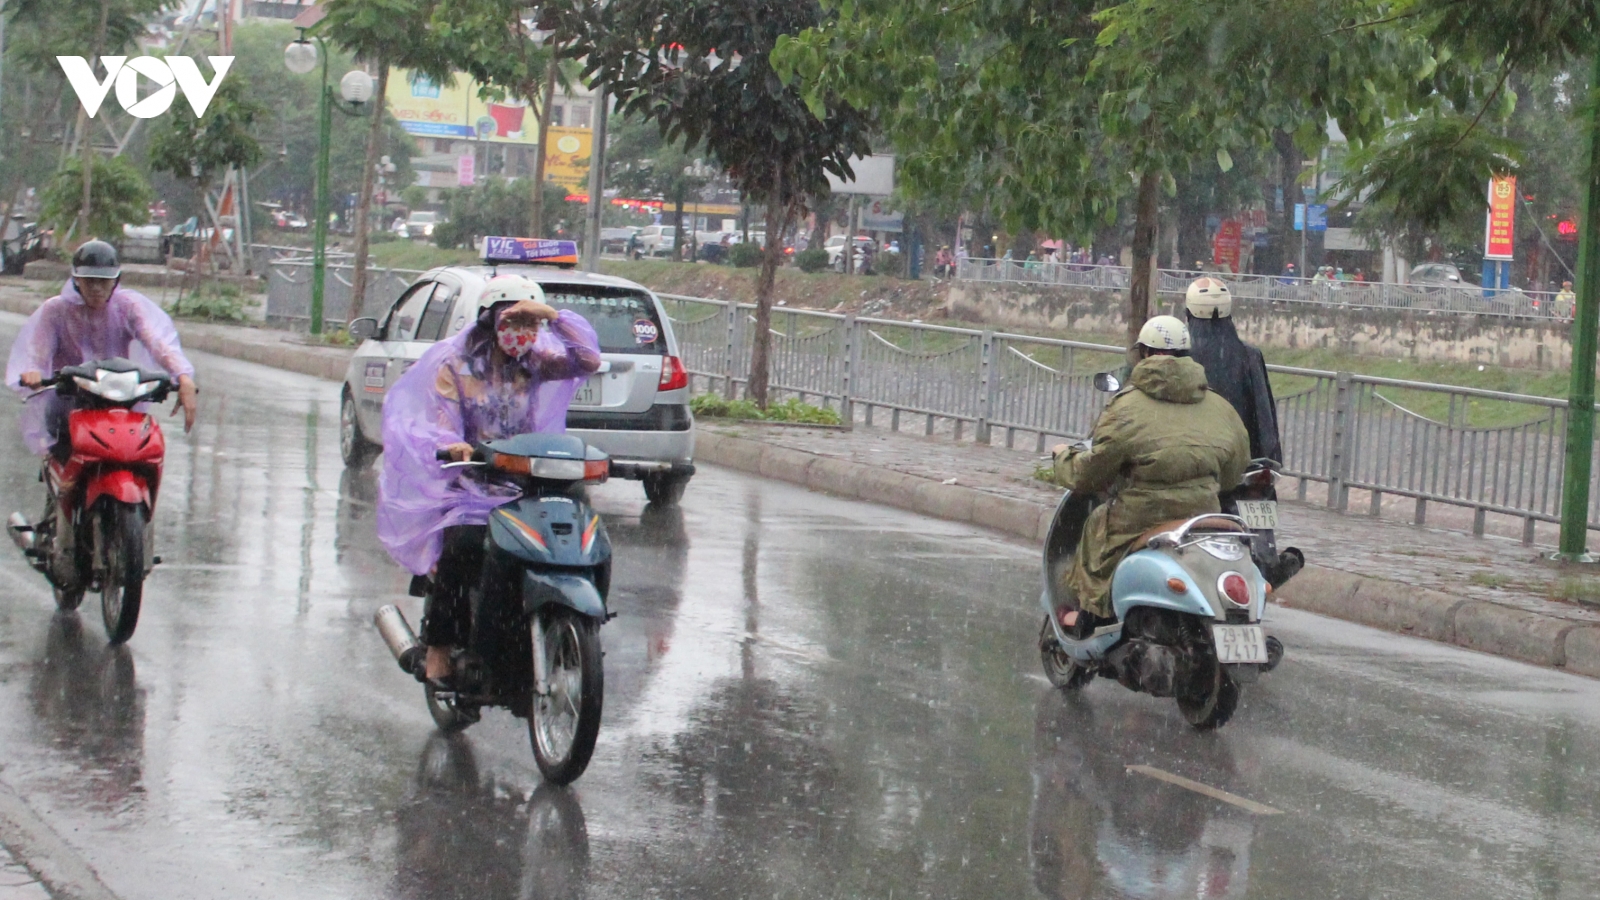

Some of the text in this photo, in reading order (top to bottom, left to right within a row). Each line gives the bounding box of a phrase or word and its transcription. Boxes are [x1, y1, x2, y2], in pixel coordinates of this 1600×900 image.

[633, 324, 657, 335] 1000
[1244, 502, 1272, 514] 16-R6
[1224, 644, 1258, 661] 7417
